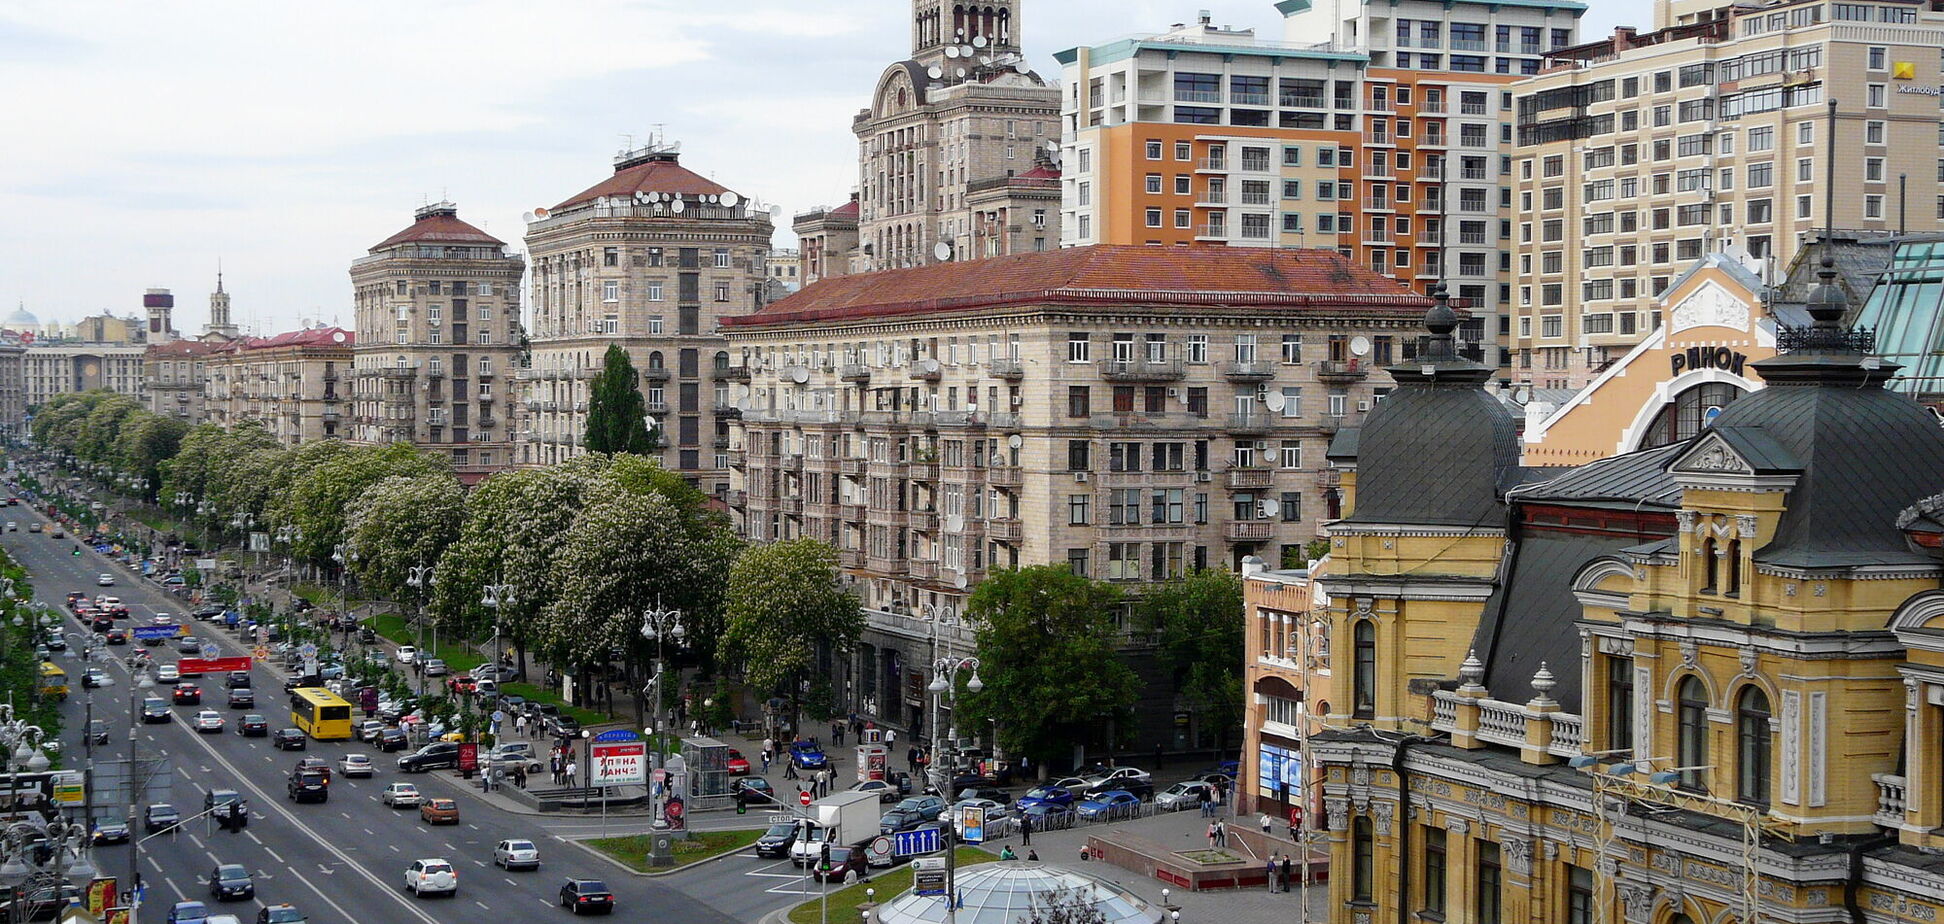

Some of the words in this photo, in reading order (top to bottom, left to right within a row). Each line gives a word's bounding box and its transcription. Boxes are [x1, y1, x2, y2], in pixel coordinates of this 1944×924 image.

[1897, 84, 1940, 96] Житлобуд
[1670, 346, 1747, 377] РИНОК
[461, 748, 474, 758] 25
